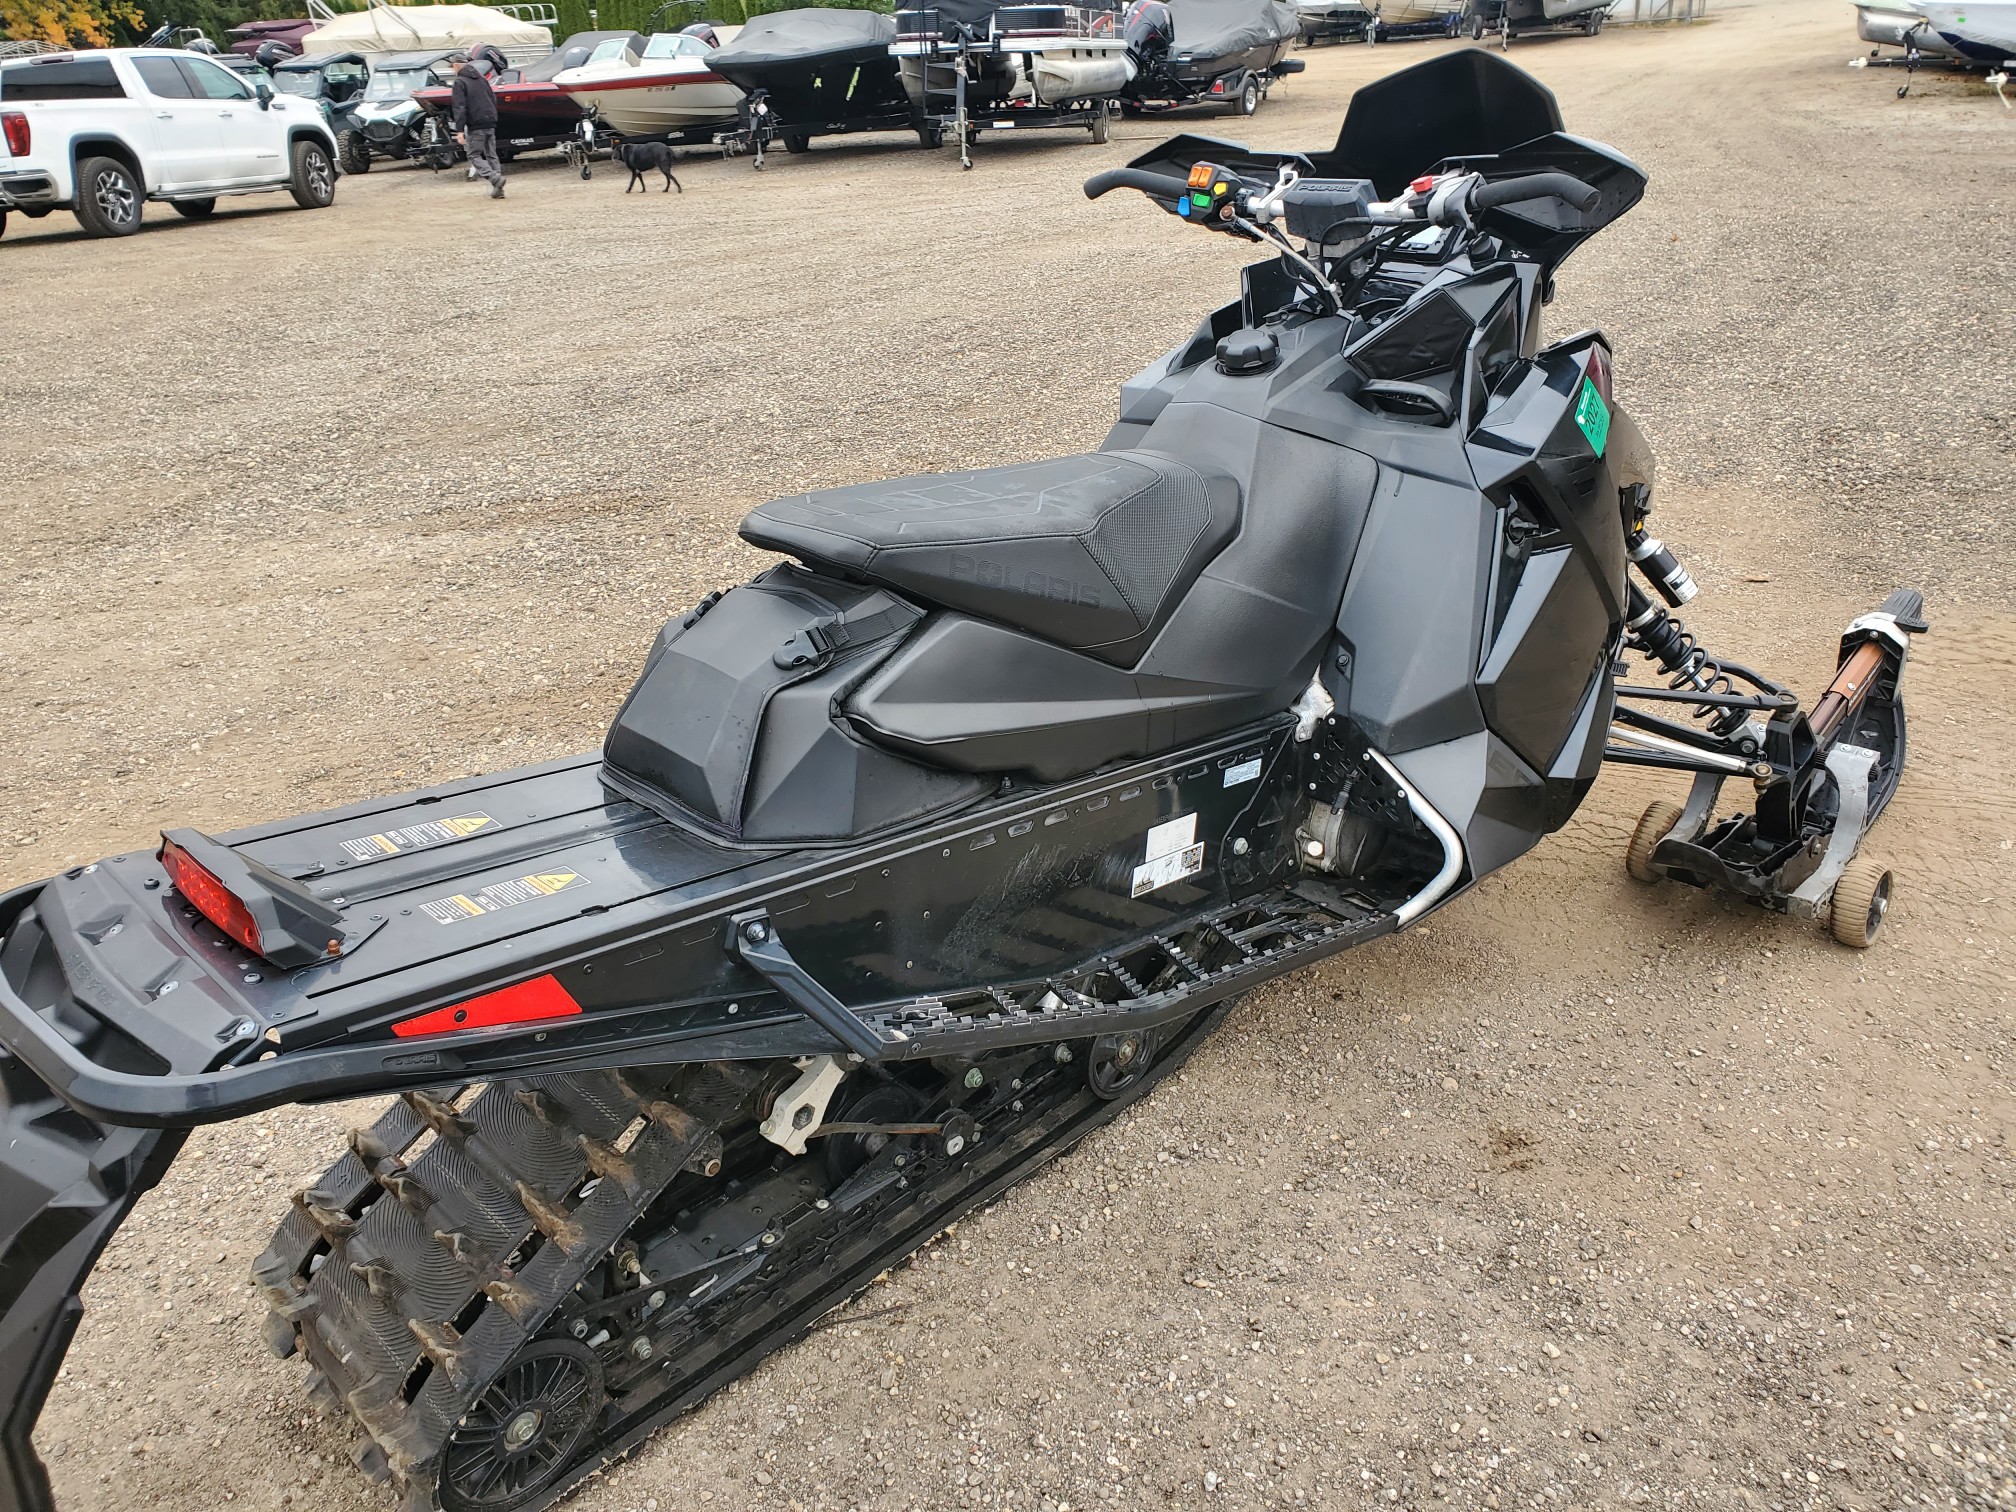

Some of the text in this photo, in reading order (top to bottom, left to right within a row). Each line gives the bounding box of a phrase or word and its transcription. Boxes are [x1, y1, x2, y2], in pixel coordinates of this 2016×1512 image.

[1299, 184, 1352, 192] POLARIS
[1585, 393, 1600, 435] 2027
[951, 553, 1101, 609] POLARIS
